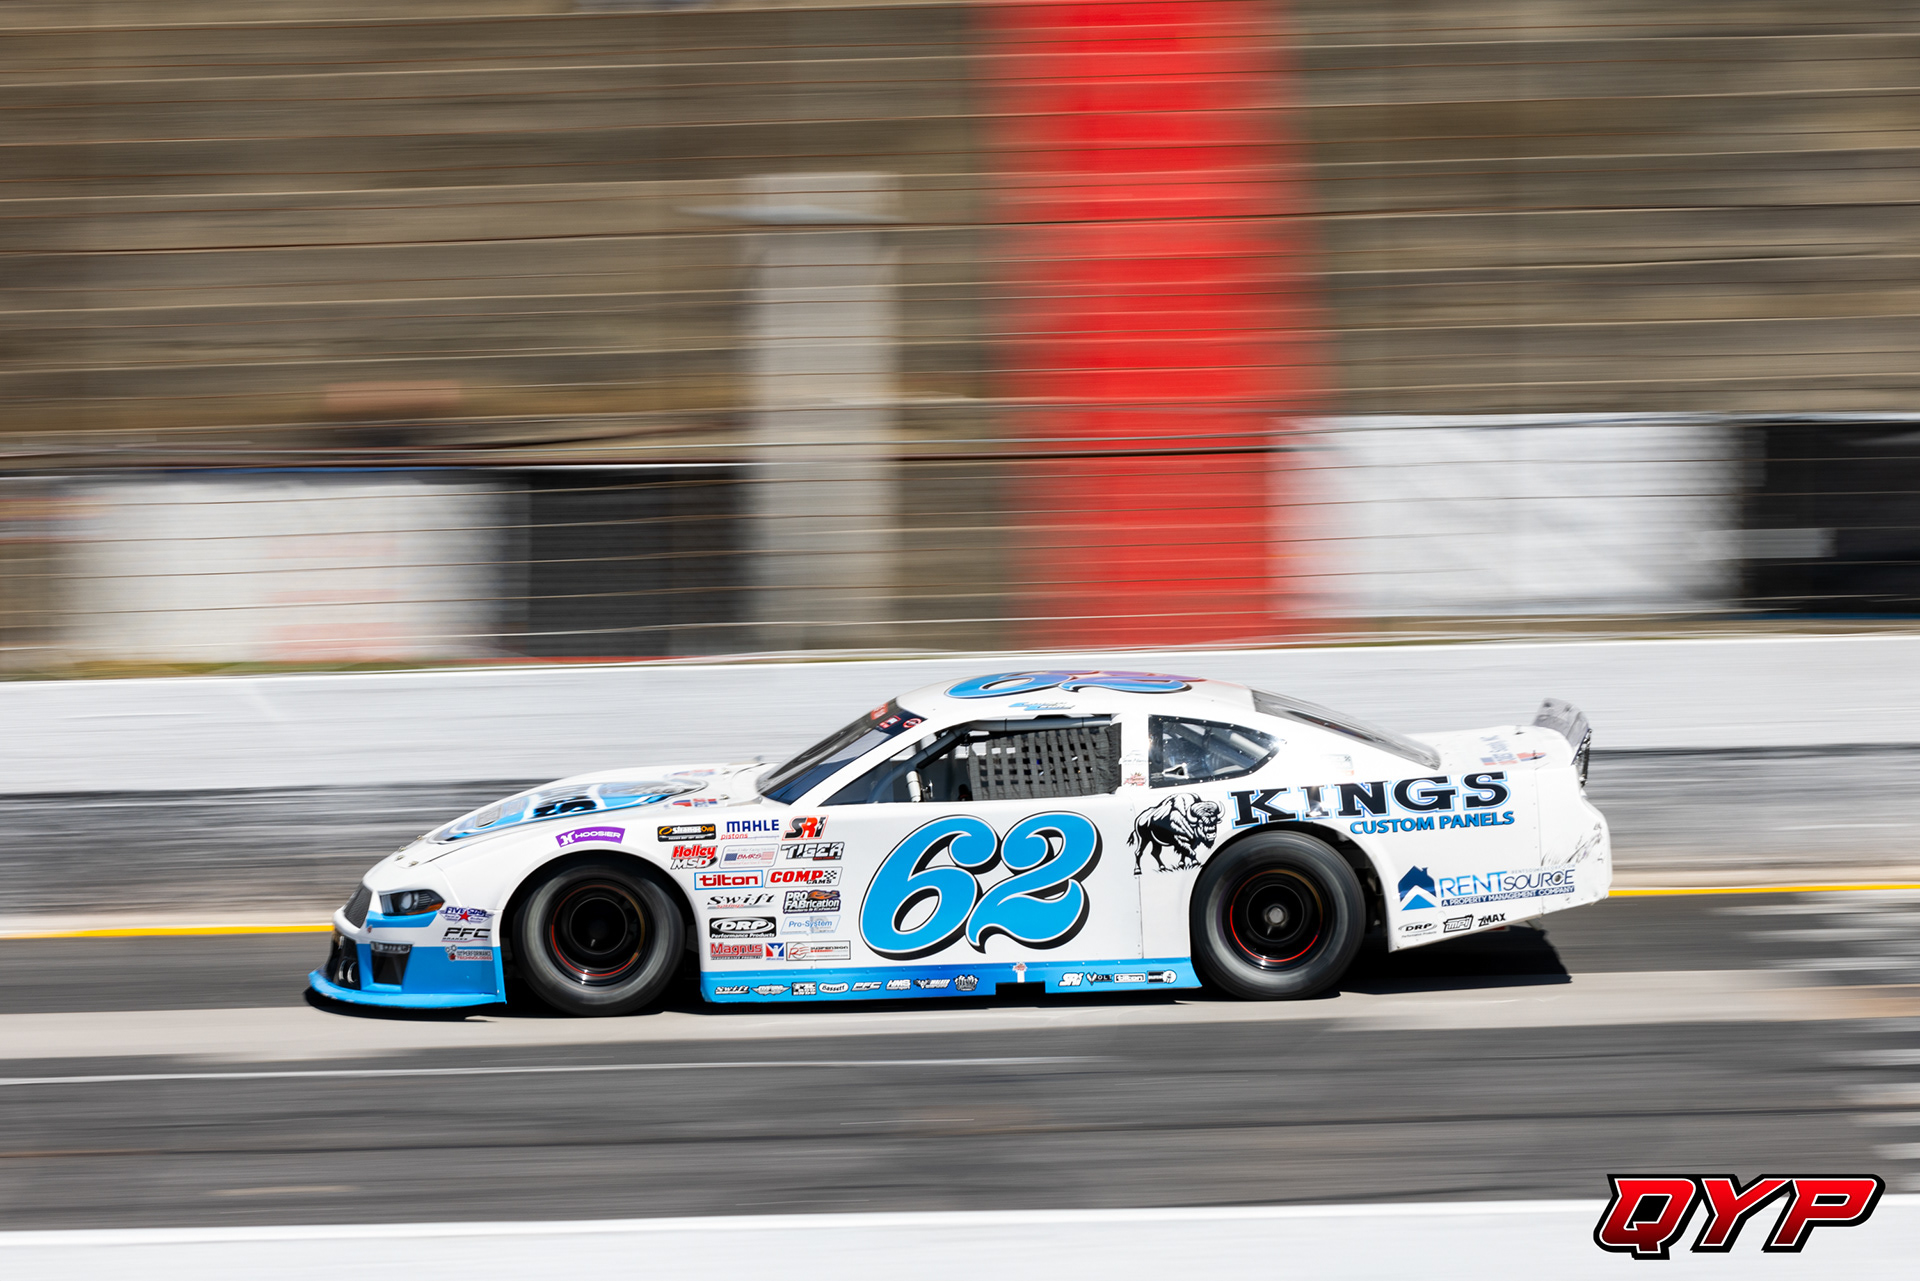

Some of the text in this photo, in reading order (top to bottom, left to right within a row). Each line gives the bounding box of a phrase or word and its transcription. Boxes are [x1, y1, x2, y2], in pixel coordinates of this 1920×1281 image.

[1228, 770, 1511, 829] KINGS
[726, 819, 780, 833] MAHLE
[1350, 810, 1515, 835] CUSTOM PANELS
[574, 830, 621, 839] HOOSIER
[720, 832, 748, 841] pistons
[671, 844, 718, 860] Holley
[780, 842, 845, 860] TIGER
[670, 857, 717, 870] MSD
[699, 874, 759, 887] tilton
[769, 870, 824, 883] COMP
[858, 809, 1103, 961] 62
[706, 893, 775, 906] Swift
[785, 891, 809, 901] PRO
[1442, 885, 1575, 907] A PROPERTY MANAGEMENT COMPANY
[445, 906, 465, 914] FIVE
[784, 898, 840, 910] FABrication
[720, 920, 768, 932] DRP
[788, 920, 833, 928] Pro-System
[1405, 922, 1433, 932] DRP
[443, 927, 491, 938] PFC
[710, 942, 763, 955] Magnus
